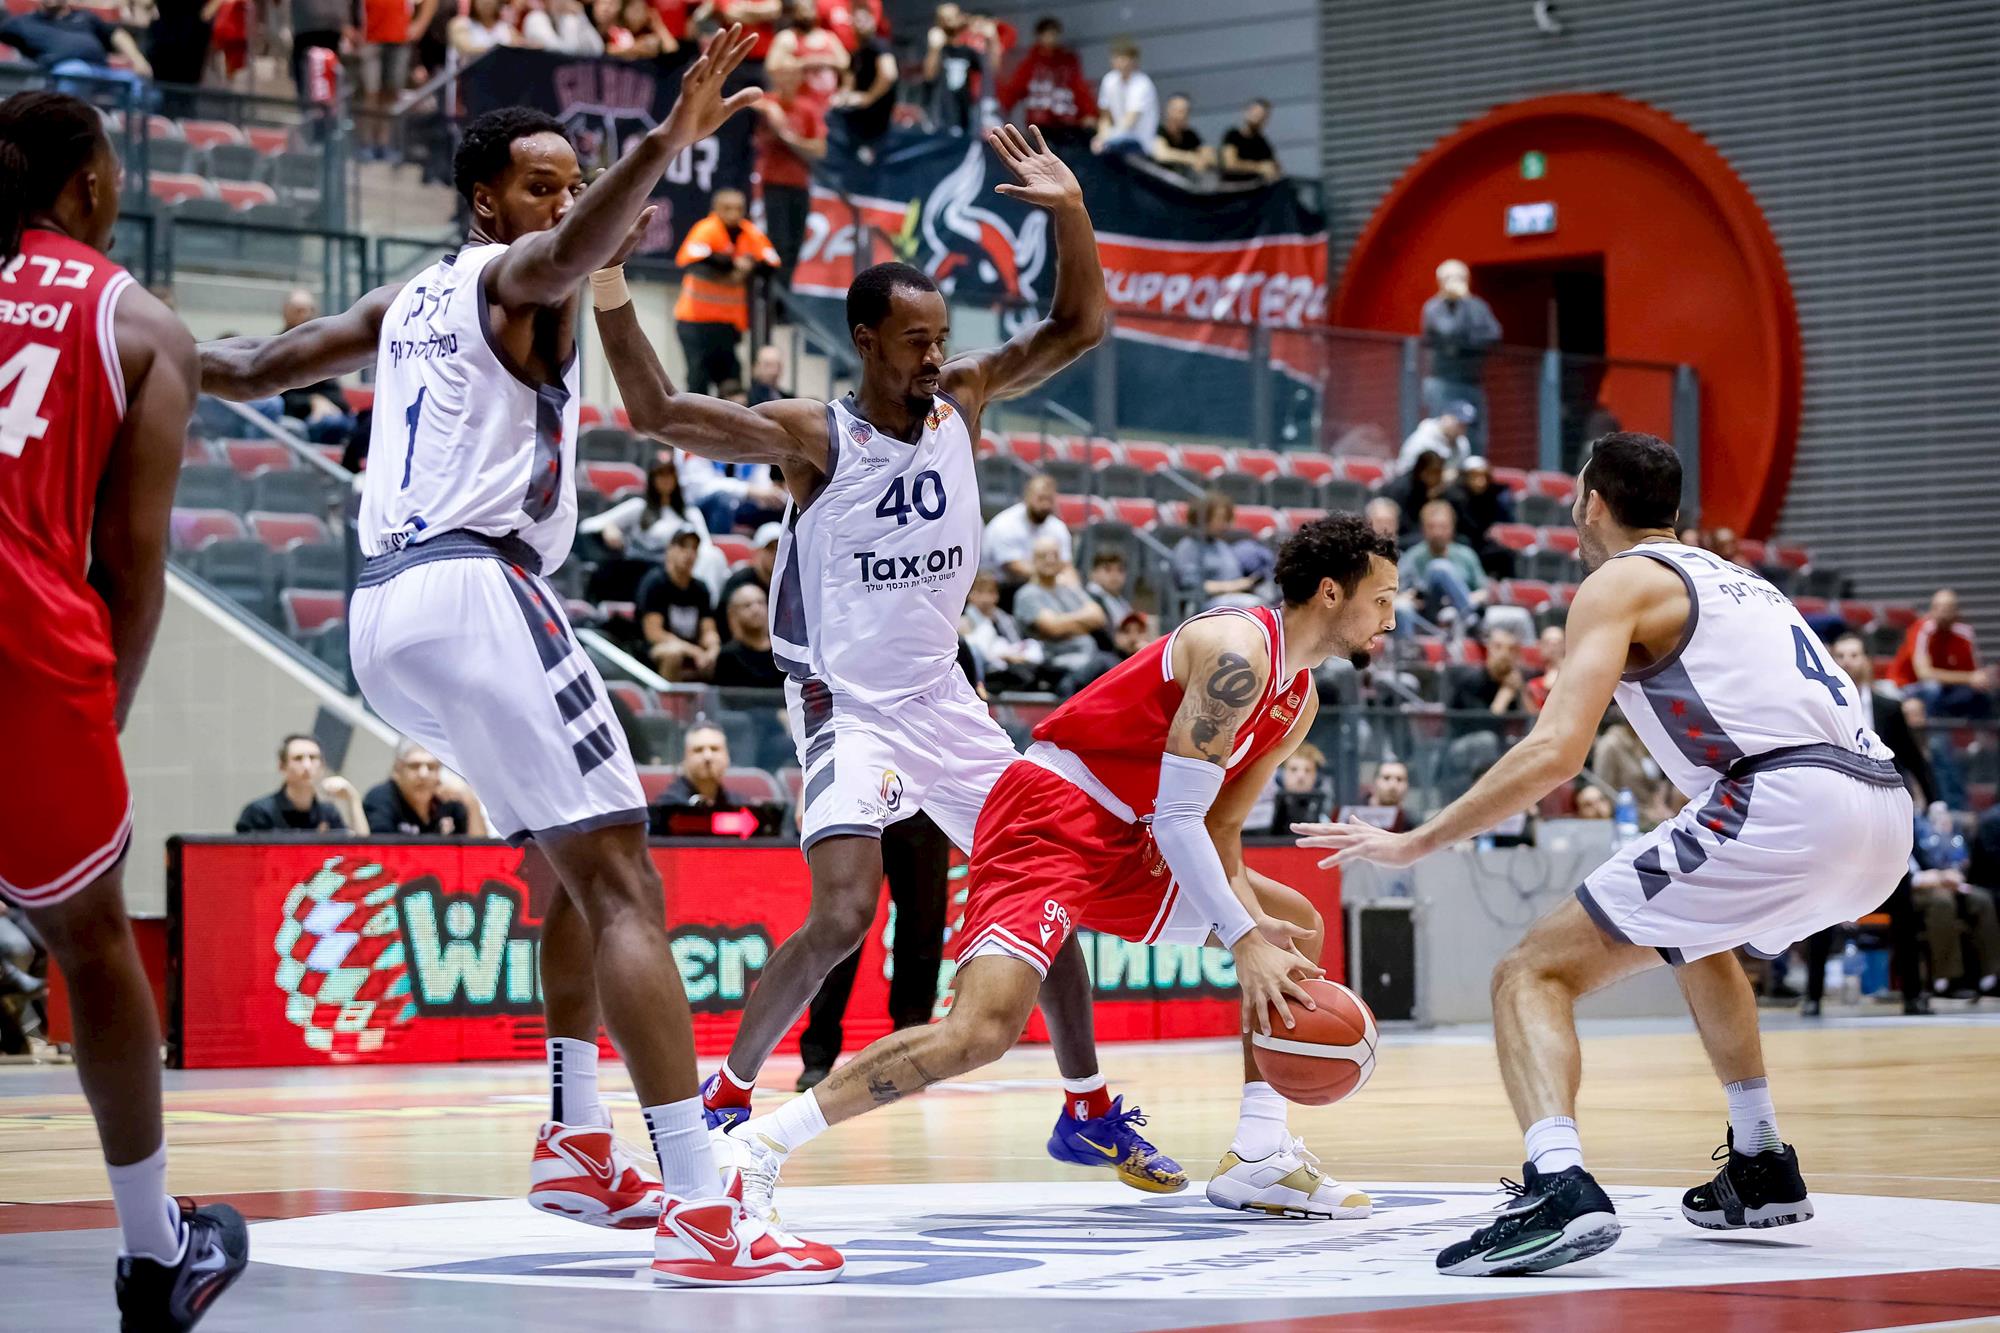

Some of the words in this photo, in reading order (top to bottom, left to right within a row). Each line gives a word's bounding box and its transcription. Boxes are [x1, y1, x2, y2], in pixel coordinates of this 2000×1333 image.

[401, 386, 426, 489] 1
[876, 470, 947, 525] 40
[865, 583, 884, 594] שלך
[886, 581, 909, 592] הכסף
[1790, 623, 1849, 707] 4
[404, 889, 769, 1003] Wier
